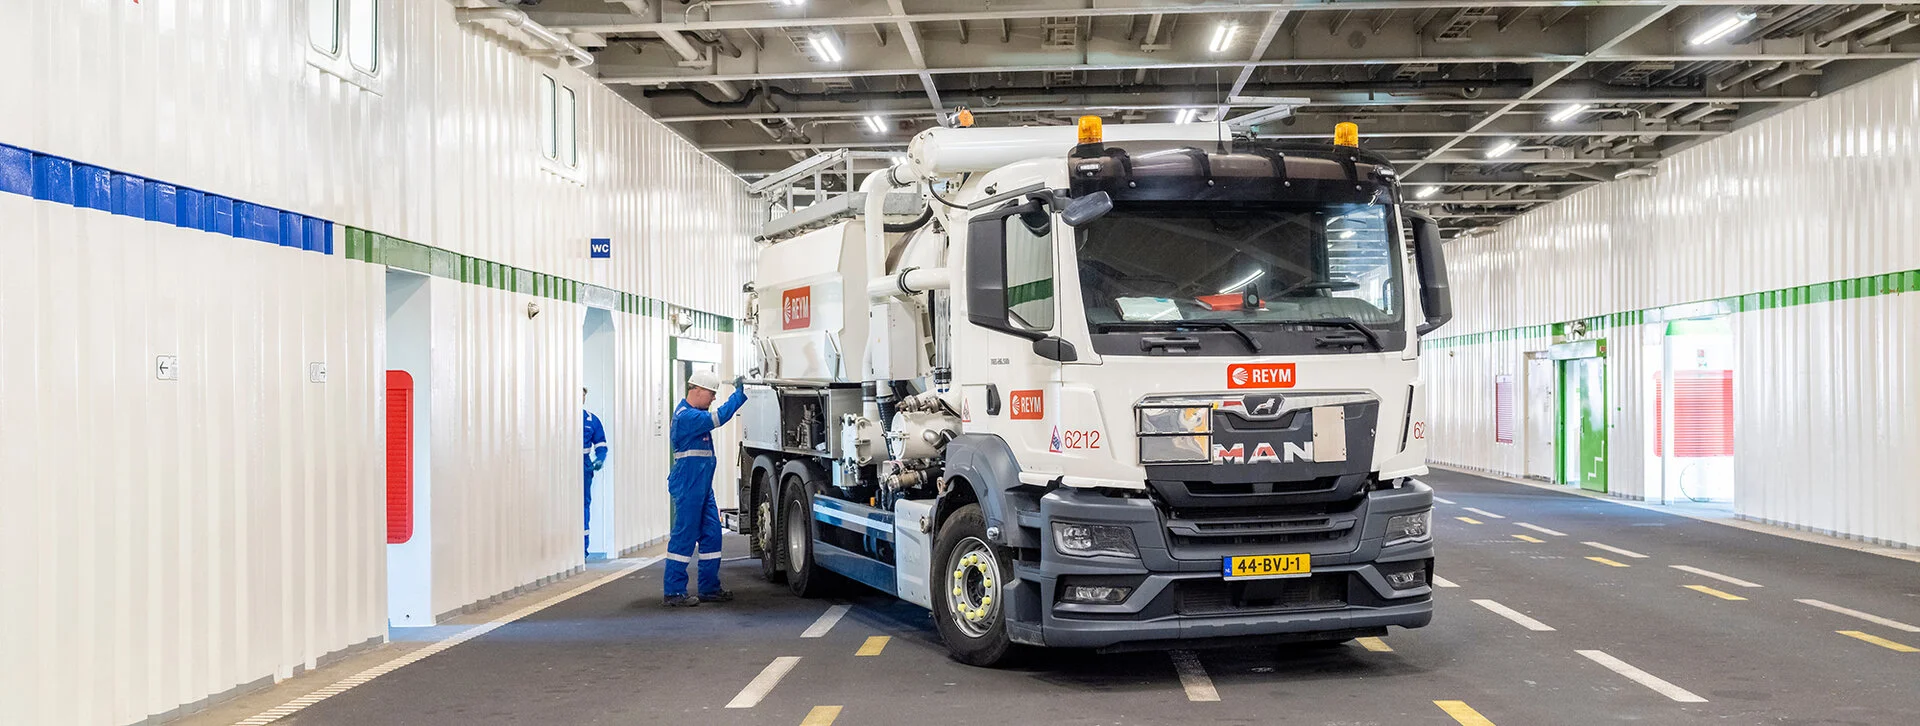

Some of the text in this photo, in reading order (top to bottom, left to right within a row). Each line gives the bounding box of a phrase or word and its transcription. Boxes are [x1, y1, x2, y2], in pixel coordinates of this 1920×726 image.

[592, 244, 609, 253] WC
[792, 296, 808, 319] REYM
[1252, 369, 1291, 383] REYM
[1021, 396, 1042, 413] REYM
[1064, 430, 1100, 449] 6212
[1212, 441, 1314, 465] MAN
[1238, 557, 1300, 573] 44-BVJ-1
